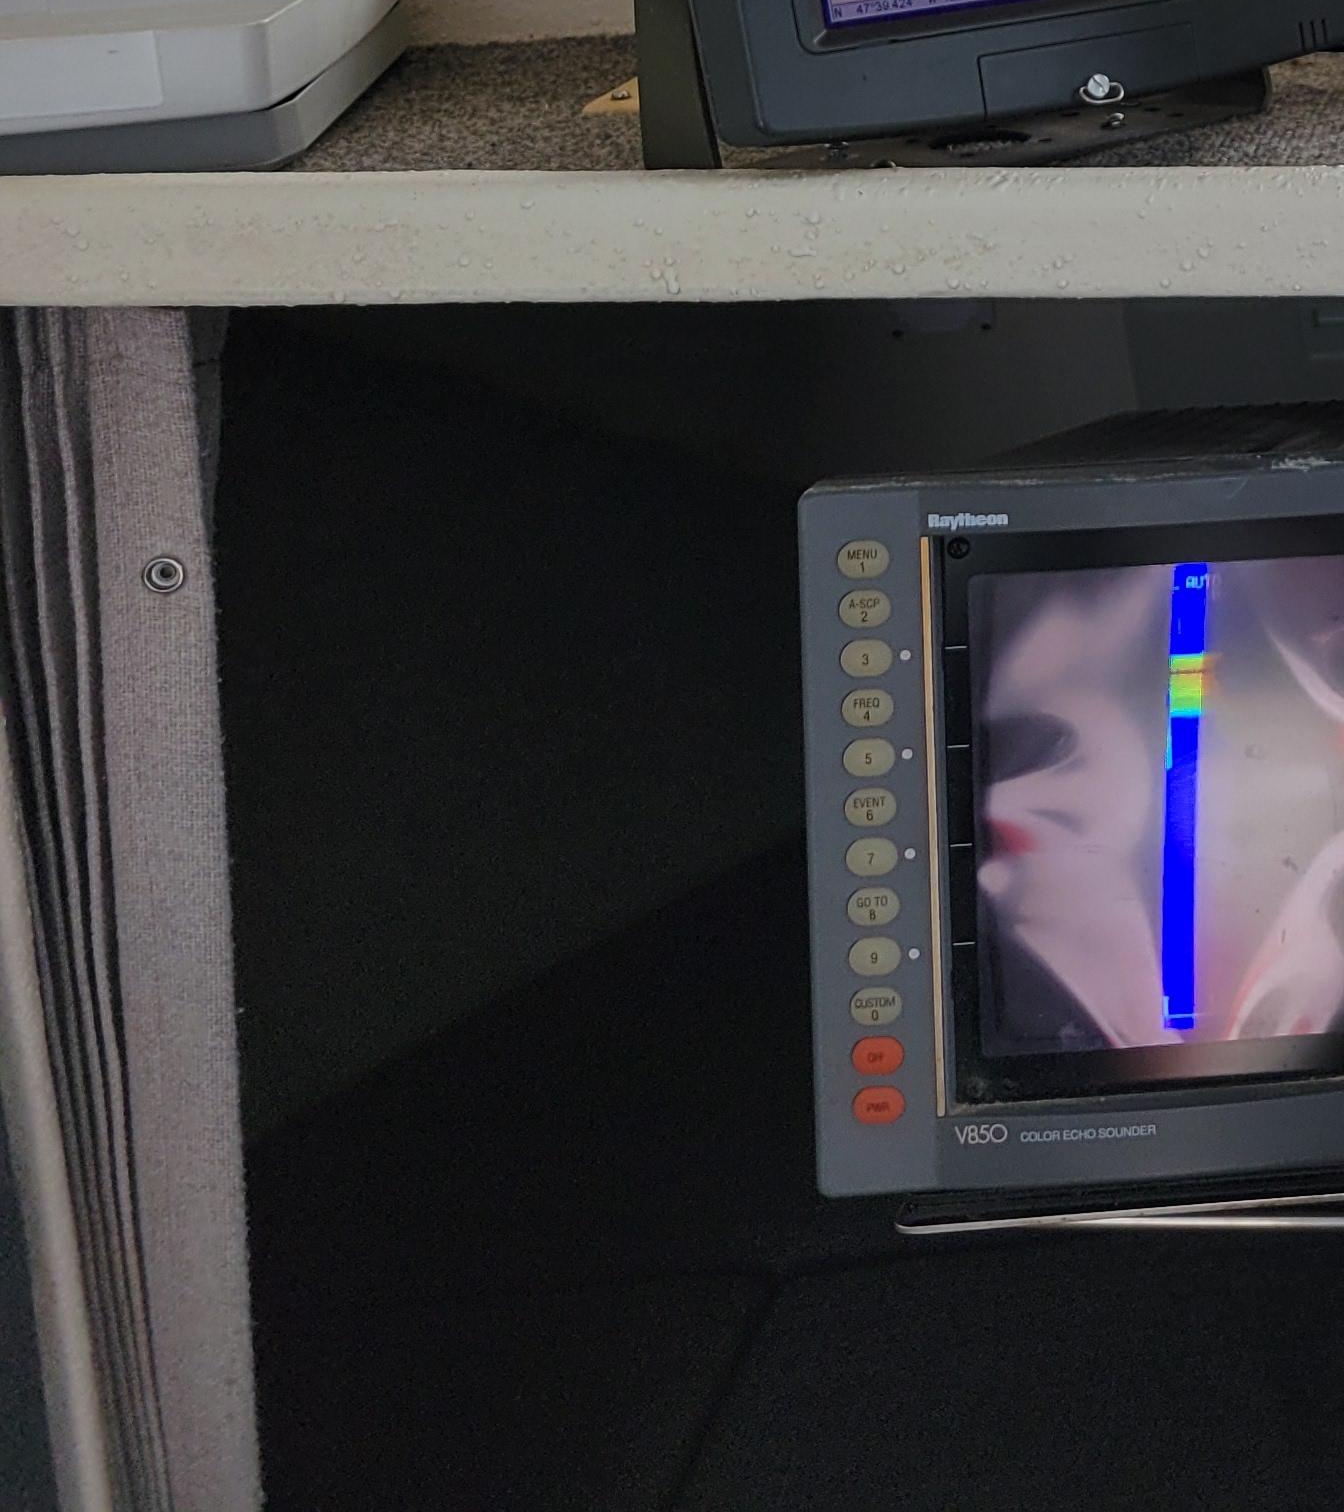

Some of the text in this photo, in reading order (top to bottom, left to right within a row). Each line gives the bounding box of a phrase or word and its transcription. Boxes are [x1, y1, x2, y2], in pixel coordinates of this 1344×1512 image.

[928, 513, 1008, 530] Raytheon
[847, 549, 877, 560] MENU
[849, 598, 880, 609] A-SCP
[862, 654, 869, 666] 3
[853, 698, 880, 708] FREQ
[853, 797, 886, 808] EVENT
[857, 896, 888, 908] GO TO
[854, 996, 896, 1008] CUSTOM
[955, 1123, 1156, 1145] V850 COLOR ECHO SOUNDER
